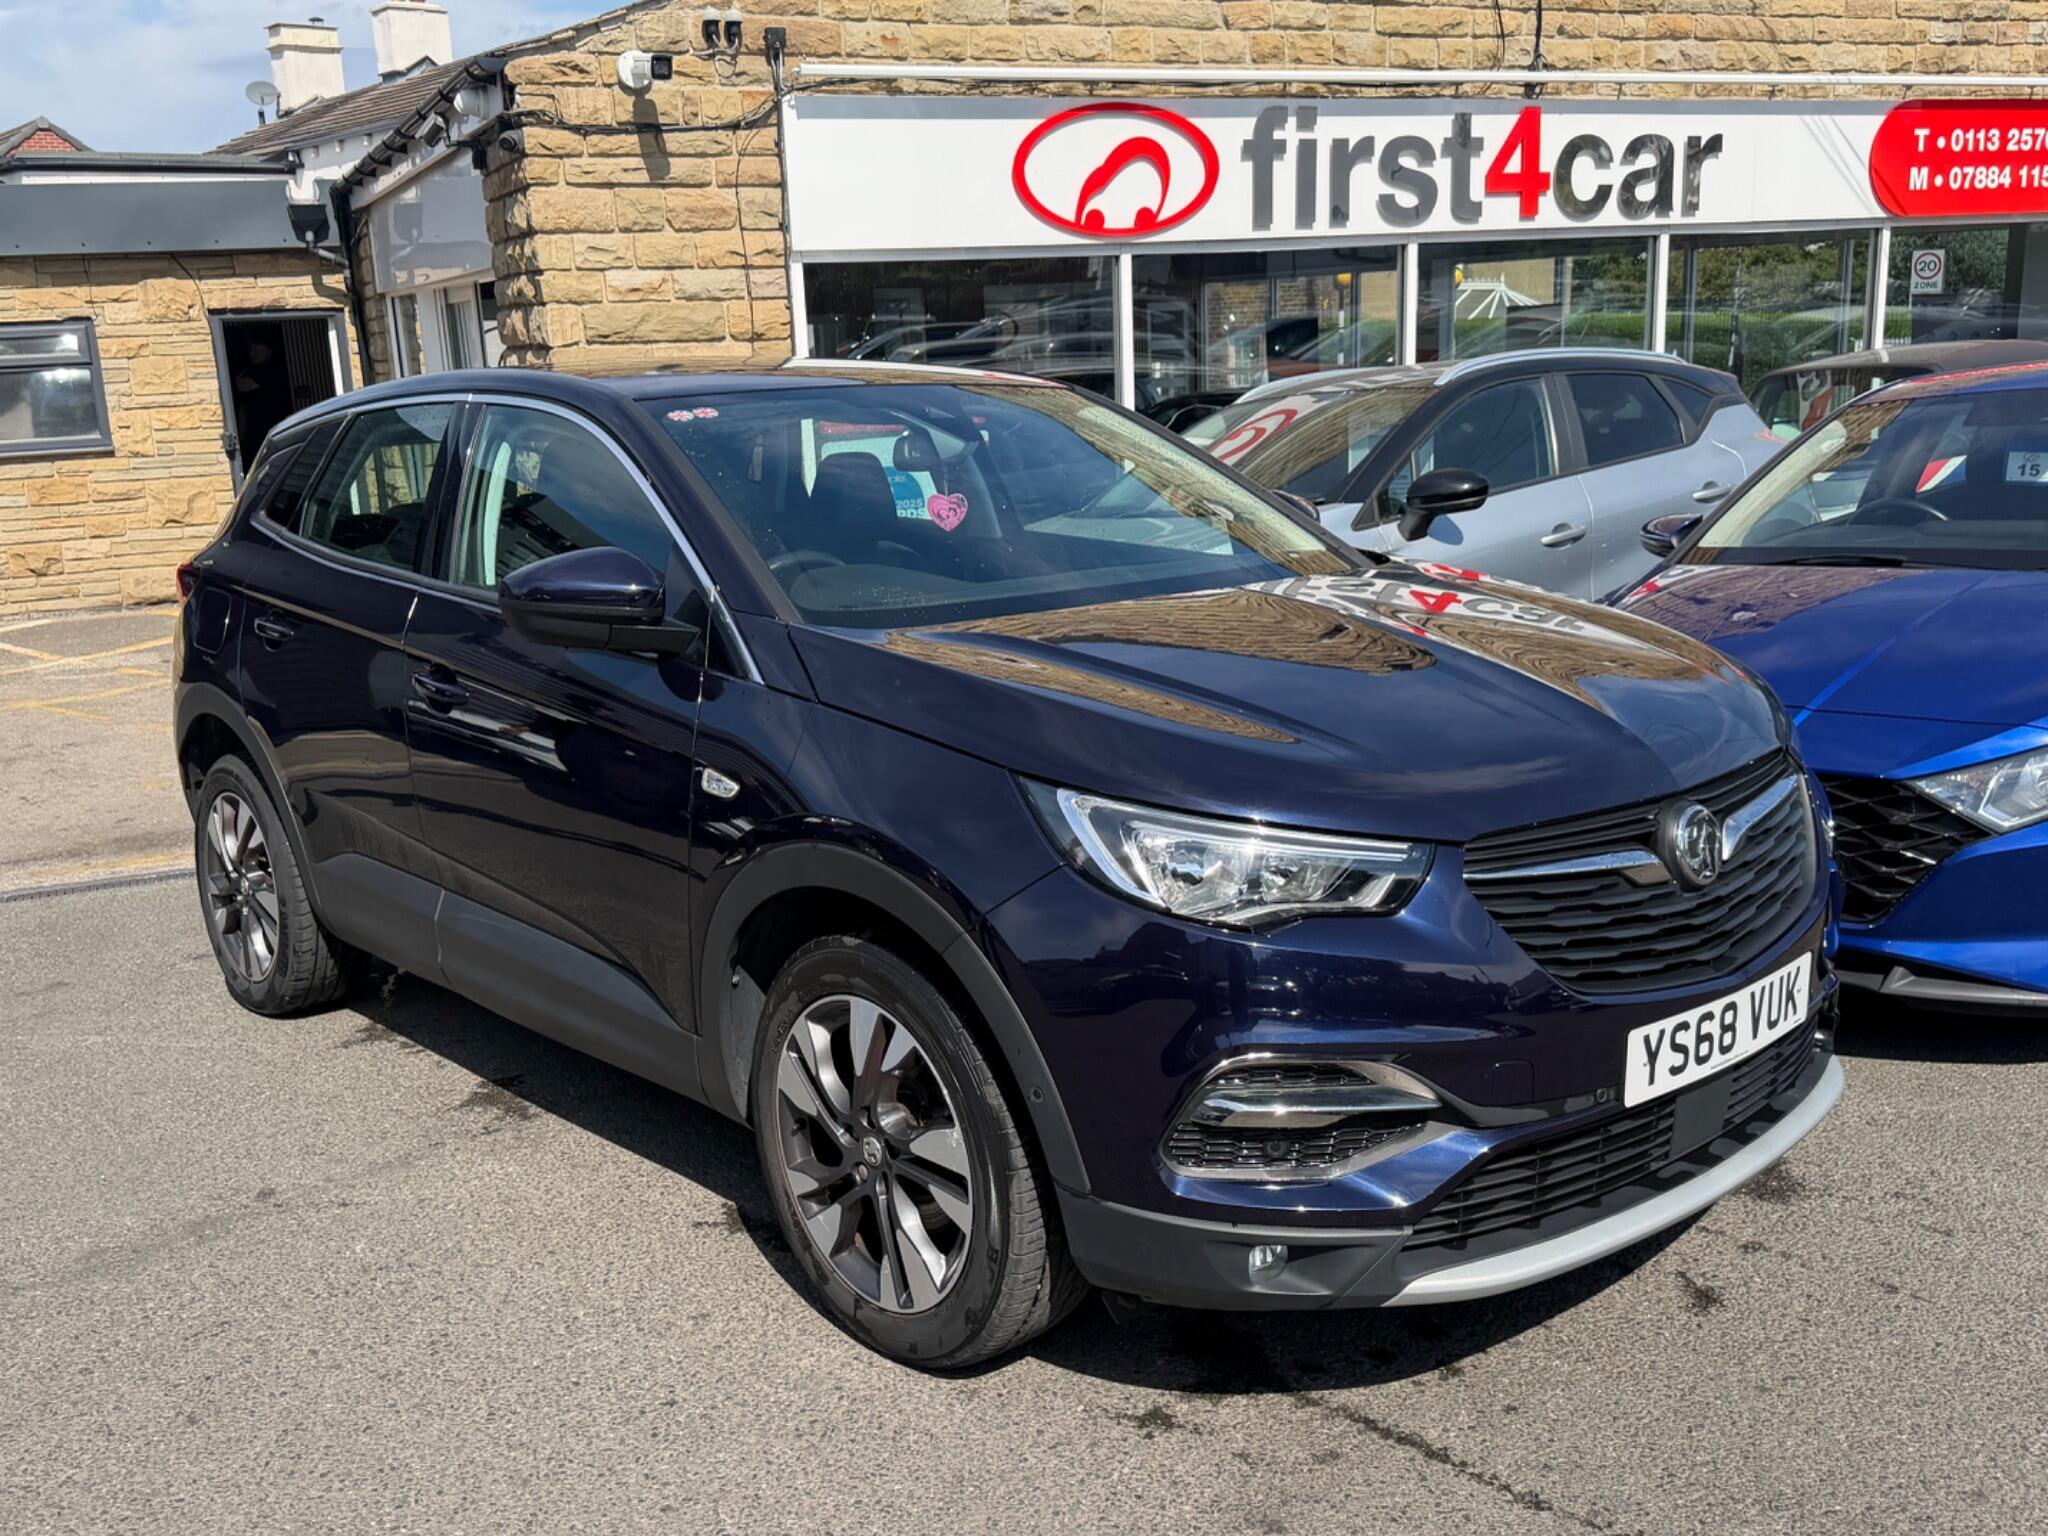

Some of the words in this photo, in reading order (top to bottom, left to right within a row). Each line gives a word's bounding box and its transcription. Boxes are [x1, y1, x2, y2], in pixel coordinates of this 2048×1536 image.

[1913, 128, 1930, 152] T
[1951, 128, 2000, 152] 0113
[1241, 105, 1723, 232] first4car
[1908, 167, 1929, 190] M
[1949, 165, 2012, 190] 07884
[1918, 260, 1937, 272] 20
[2017, 463, 2041, 477] 15
[1642, 1000, 1738, 1087] YS68
[1750, 965, 1801, 1041] VUK
